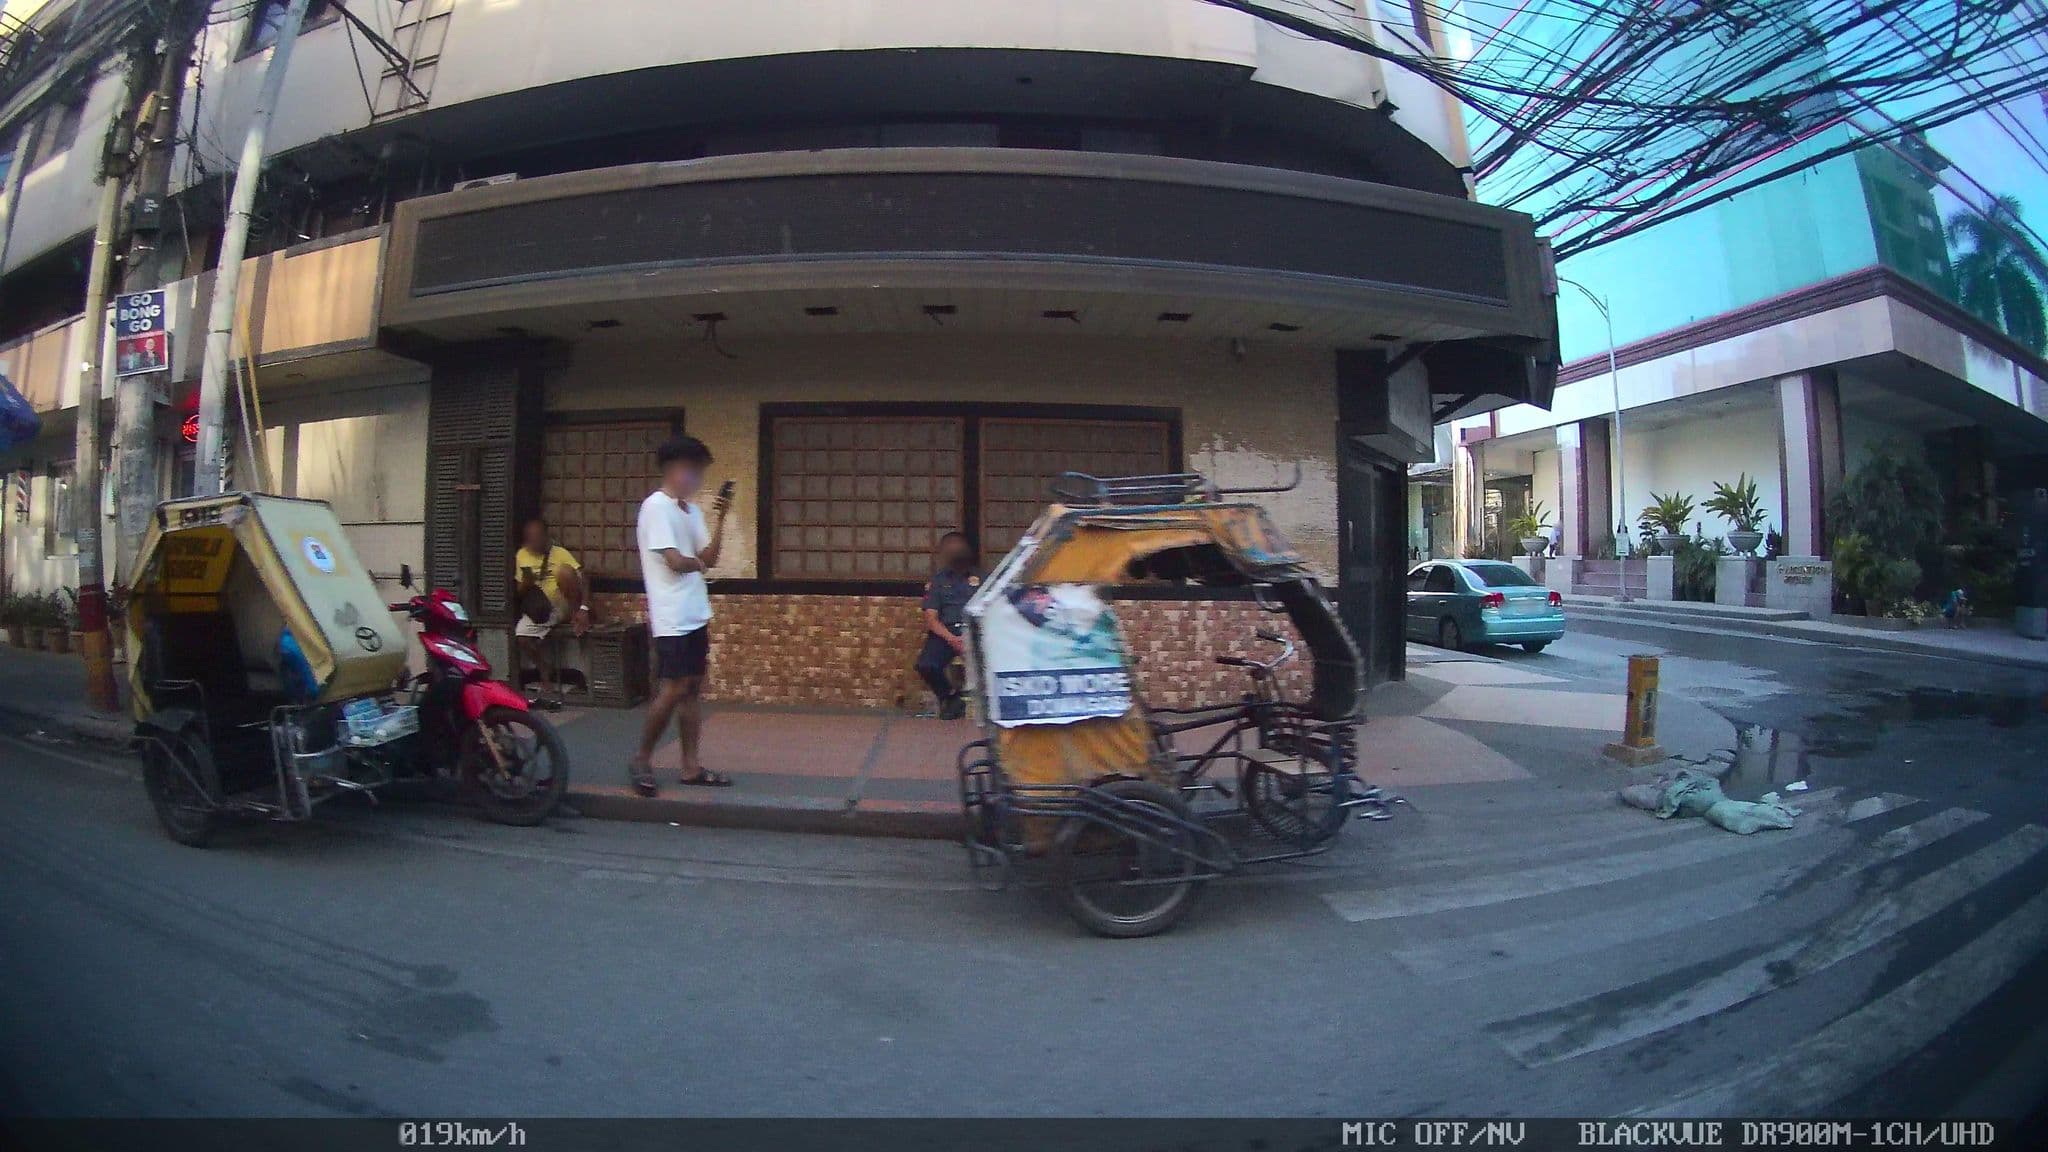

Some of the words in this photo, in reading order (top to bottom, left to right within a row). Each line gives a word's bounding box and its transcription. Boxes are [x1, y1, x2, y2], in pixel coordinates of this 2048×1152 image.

[129, 293, 152, 307] GO
[120, 304, 161, 321] BONG
[129, 318, 152, 332] GO
